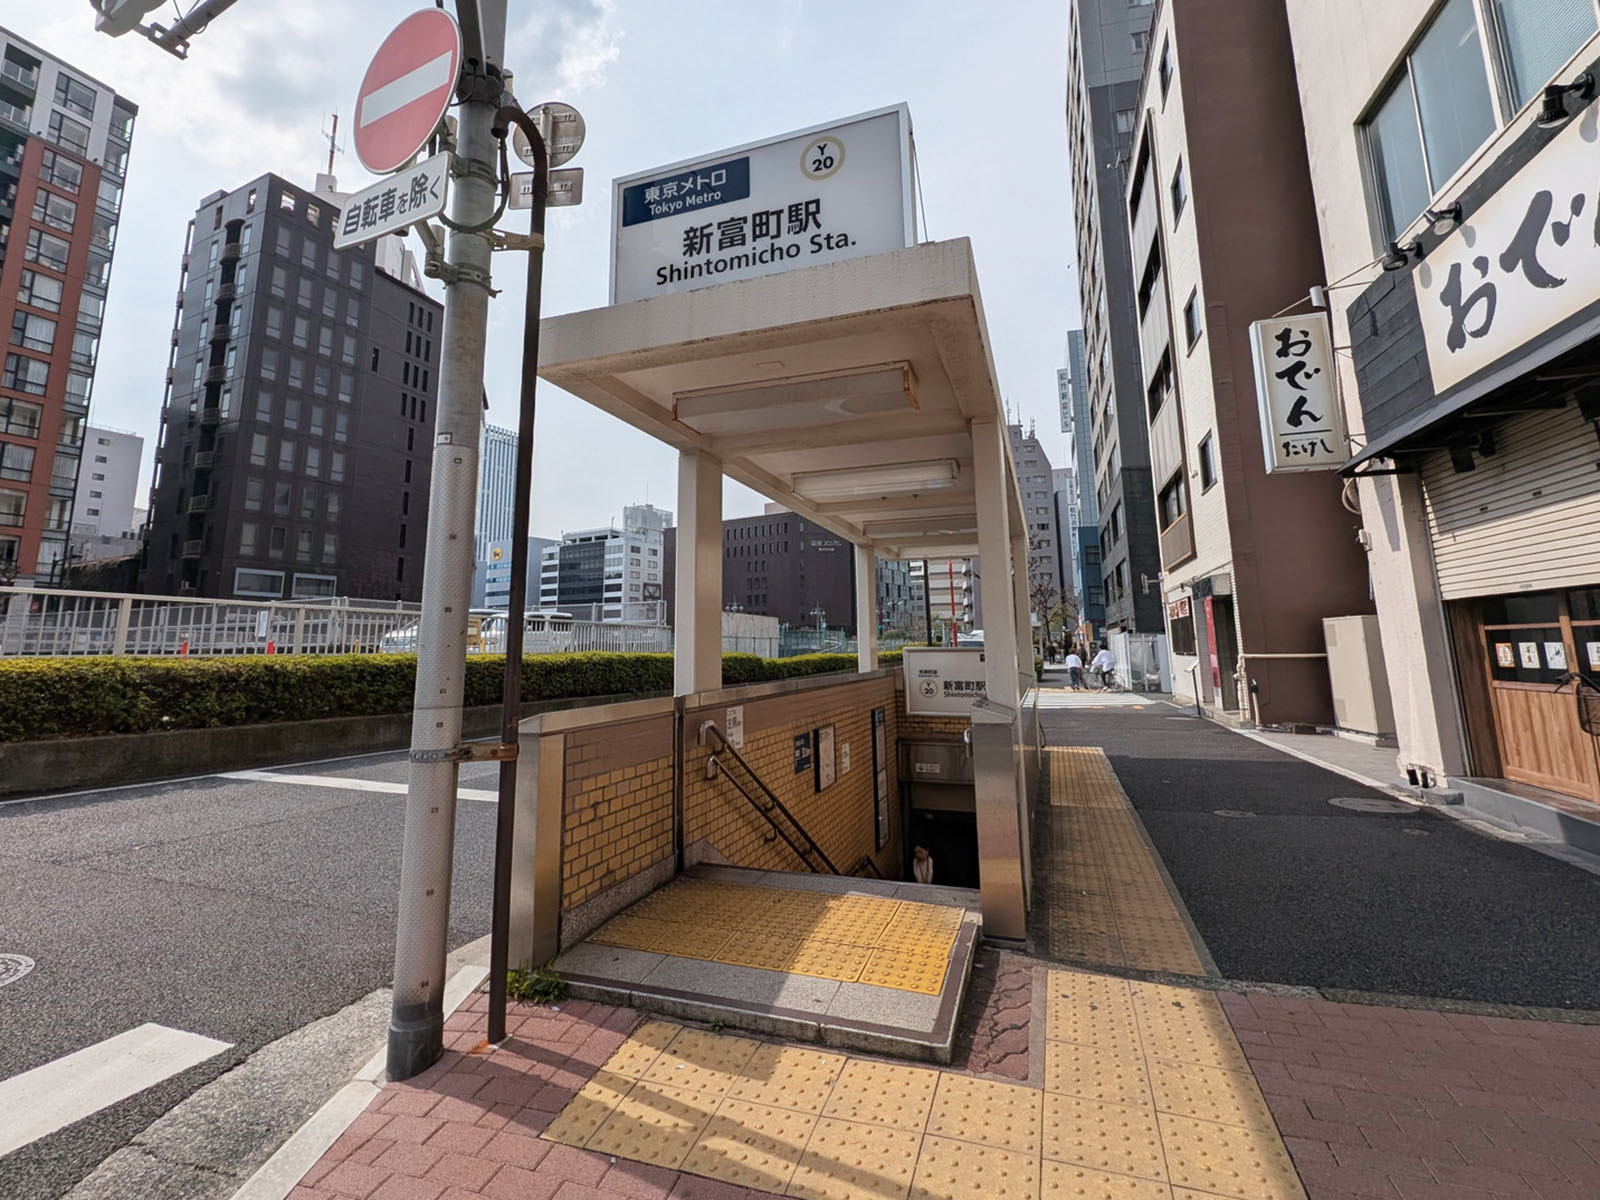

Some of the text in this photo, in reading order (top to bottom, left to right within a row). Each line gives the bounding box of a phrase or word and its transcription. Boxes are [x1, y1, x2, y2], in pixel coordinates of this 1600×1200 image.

[812, 155, 835, 173] 20
[817, 143, 828, 156] Y
[643, 168, 727, 204] 東京メトロ
[342, 172, 441, 236] 自転車を除く
[649, 189, 722, 216] Tokyo Metro
[682, 198, 822, 258] 新富町駅
[656, 230, 857, 286] Shintomicho Sta.
[1440, 188, 1600, 353] おで
[1274, 327, 1324, 428] おでん
[1282, 438, 1334, 457] たけし
[923, 687, 934, 695] 20
[943, 680, 986, 691] 新富町駅
